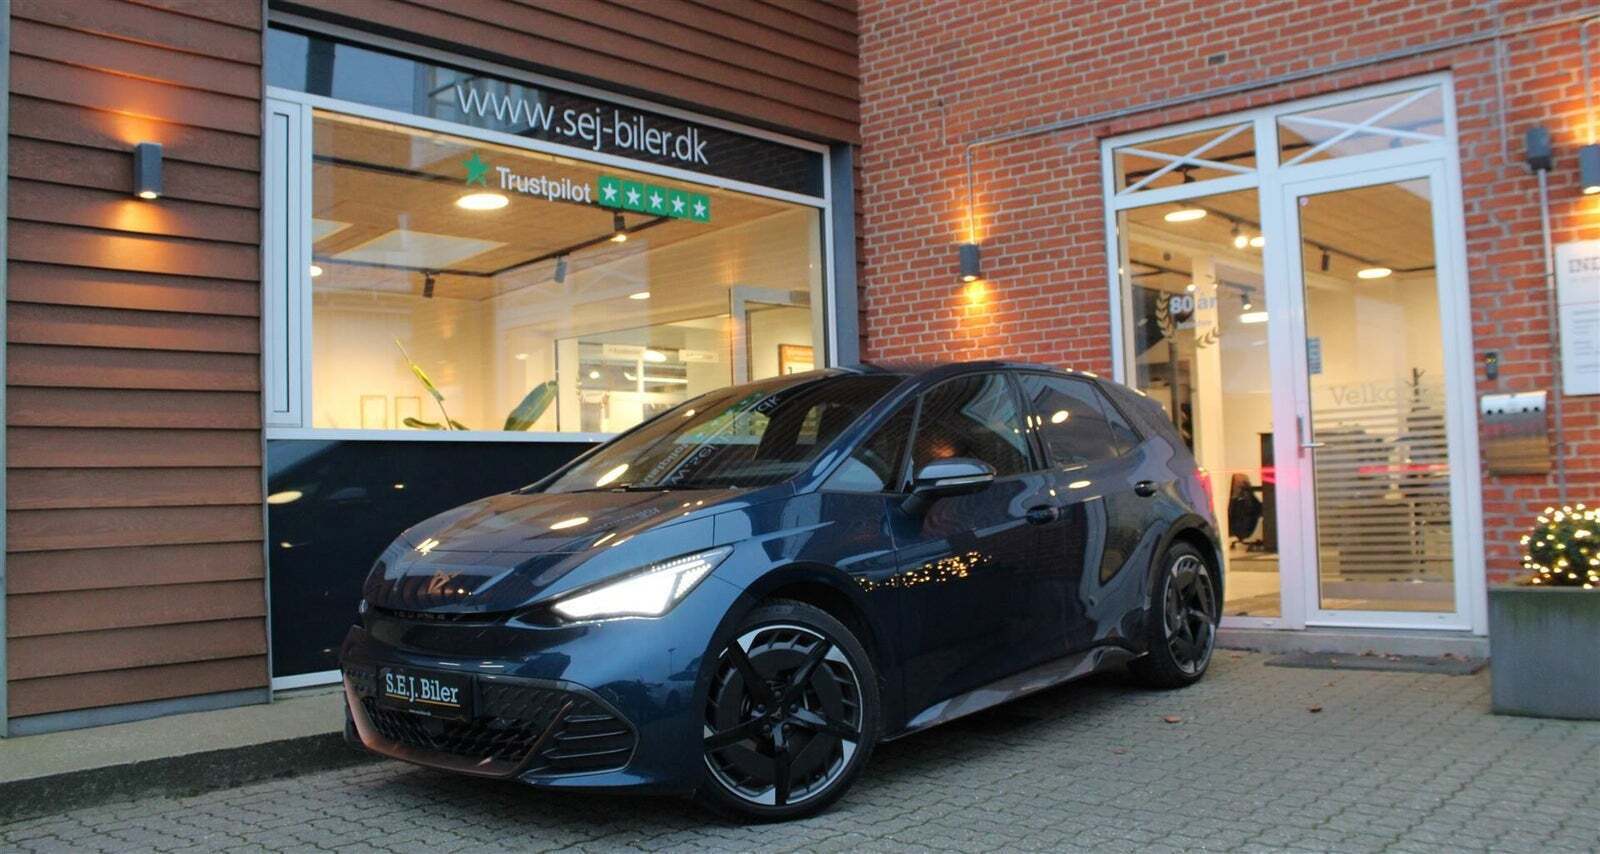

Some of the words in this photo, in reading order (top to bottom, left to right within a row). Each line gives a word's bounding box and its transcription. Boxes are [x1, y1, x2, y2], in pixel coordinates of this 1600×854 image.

[457, 85, 709, 165] www.sej-biler.dk
[496, 166, 592, 203] Trustpilot
[1169, 295, 1195, 314] 80
[386, 672, 418, 702] S.E.J.
[421, 678, 459, 703] Biler
